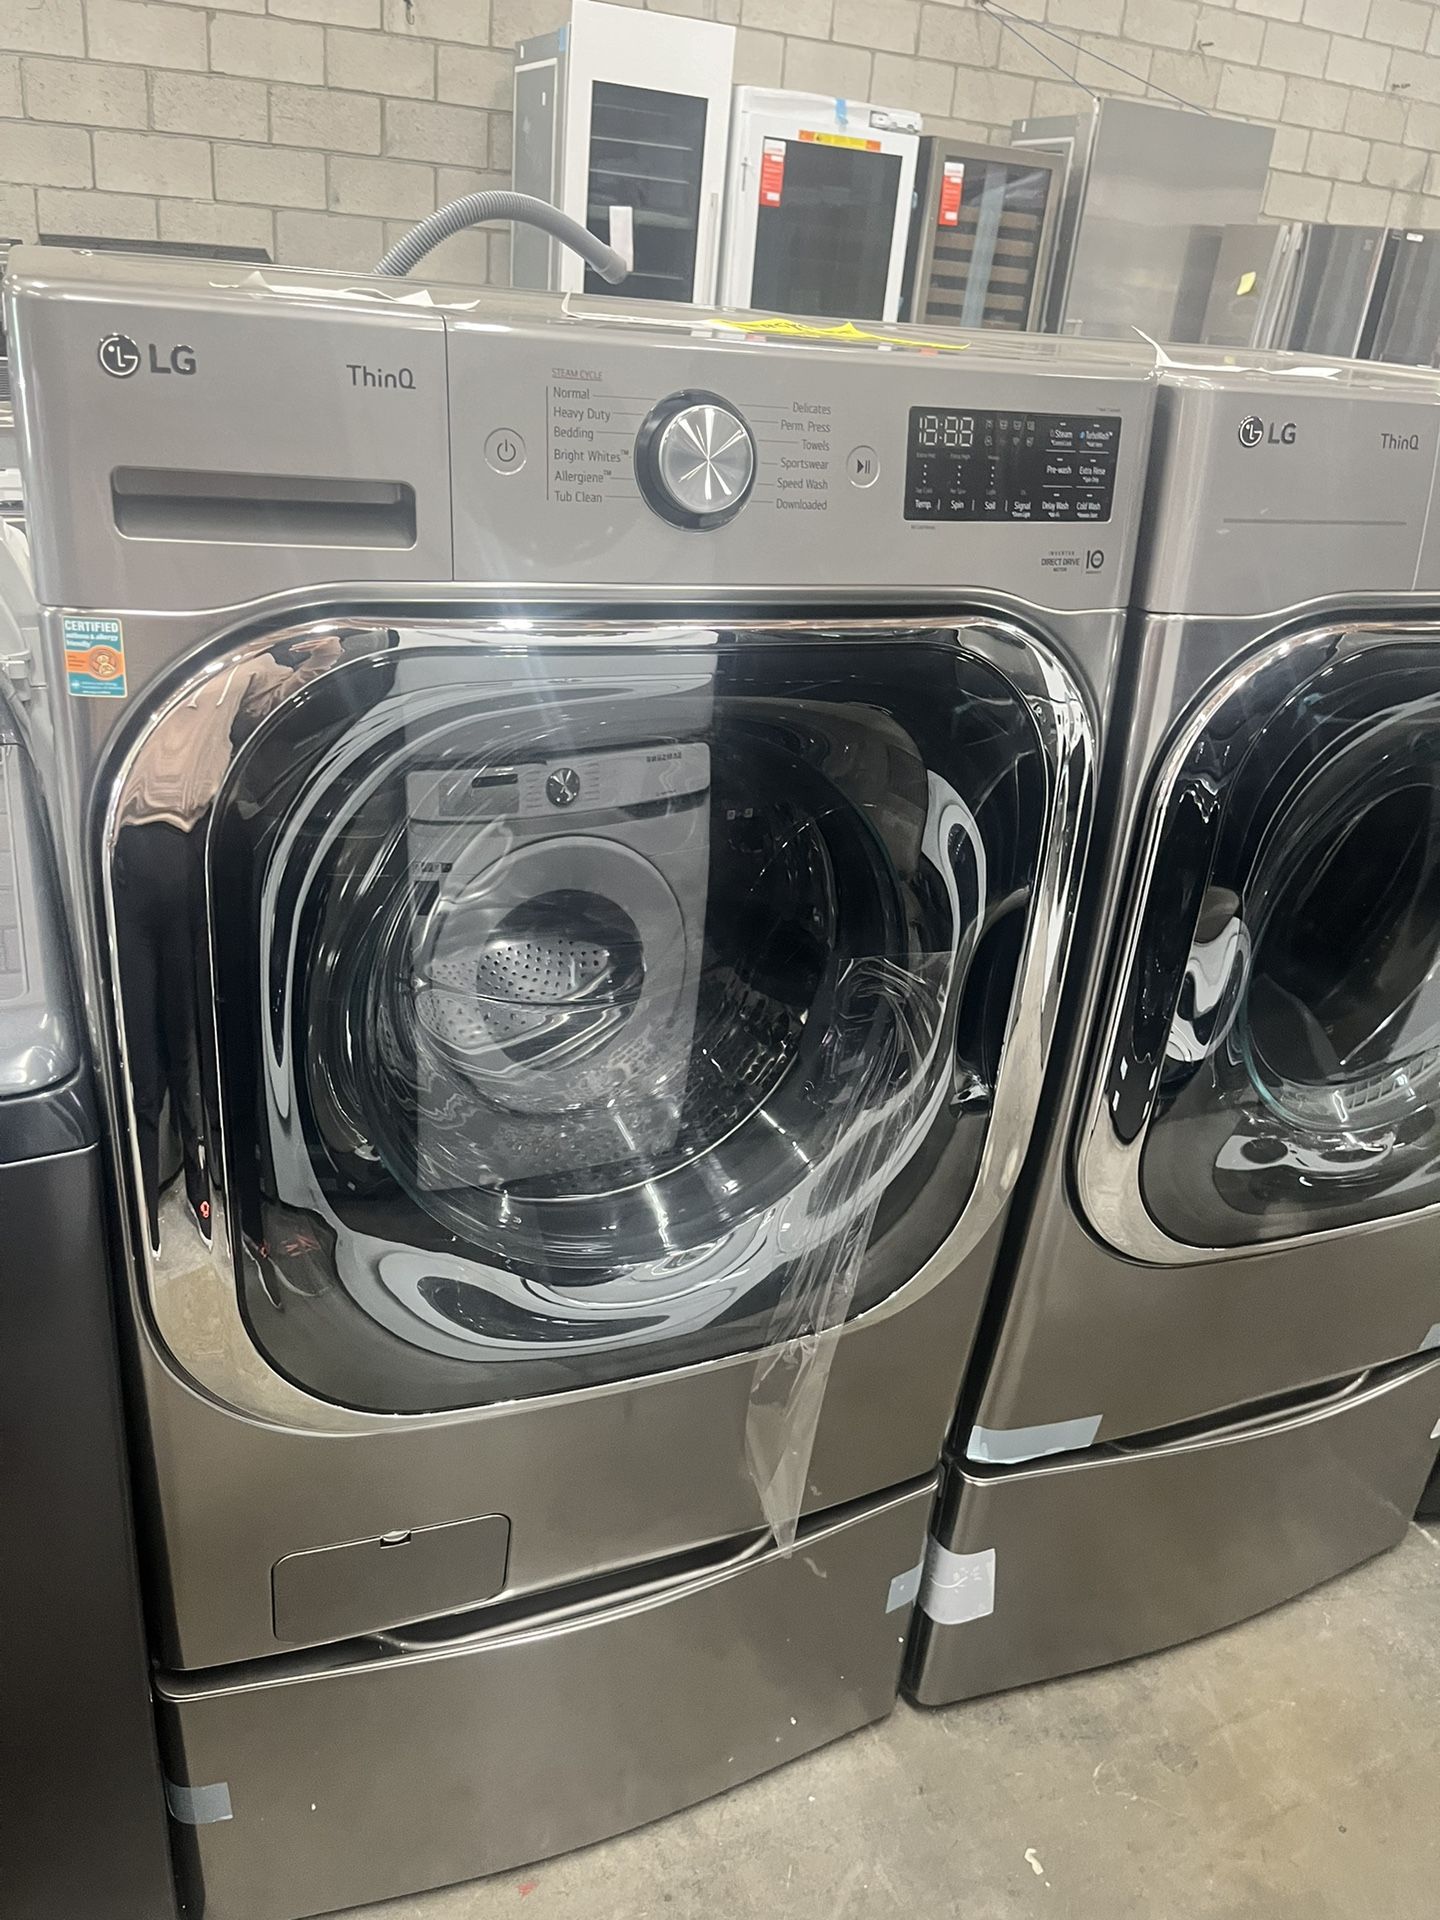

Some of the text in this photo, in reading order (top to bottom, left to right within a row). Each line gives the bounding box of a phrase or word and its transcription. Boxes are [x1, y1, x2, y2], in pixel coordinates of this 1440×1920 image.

[149, 343, 197, 375] LG
[346, 364, 417, 390] ThinQ
[552, 368, 603, 381] STEAM CYCLE
[553, 386, 591, 400] Normal
[553, 406, 611, 423] Heavy Duty
[792, 401, 832, 415] Delicates
[780, 419, 831, 433] Perm. Press
[918, 415, 975, 448] 18:88
[553, 426, 594, 442] Bedding
[1055, 429, 1073, 439] Steam
[1267, 422, 1297, 445] LG
[802, 439, 830, 452] Towels
[1380, 432, 1420, 451] ThinQ
[554, 448, 584, 464] Bright
[781, 456, 829, 471] Sportswear
[1046, 465, 1073, 475] Pre-wash
[1079, 466, 1106, 476] Extra Rinse
[777, 477, 828, 491] Speed Wash
[554, 490, 602, 503] Tub Clean
[776, 498, 828, 511] Downloaded
[950, 499, 965, 511] Spin
[984, 501, 997, 511] Soil
[1013, 501, 1032, 512] Signal
[1041, 501, 1069, 512] Delay Wash
[1076, 502, 1101, 511] Cold Wash
[1041, 558, 1081, 566] DIRECT DRIVE
[64, 619, 119, 633] CERTIFIED
